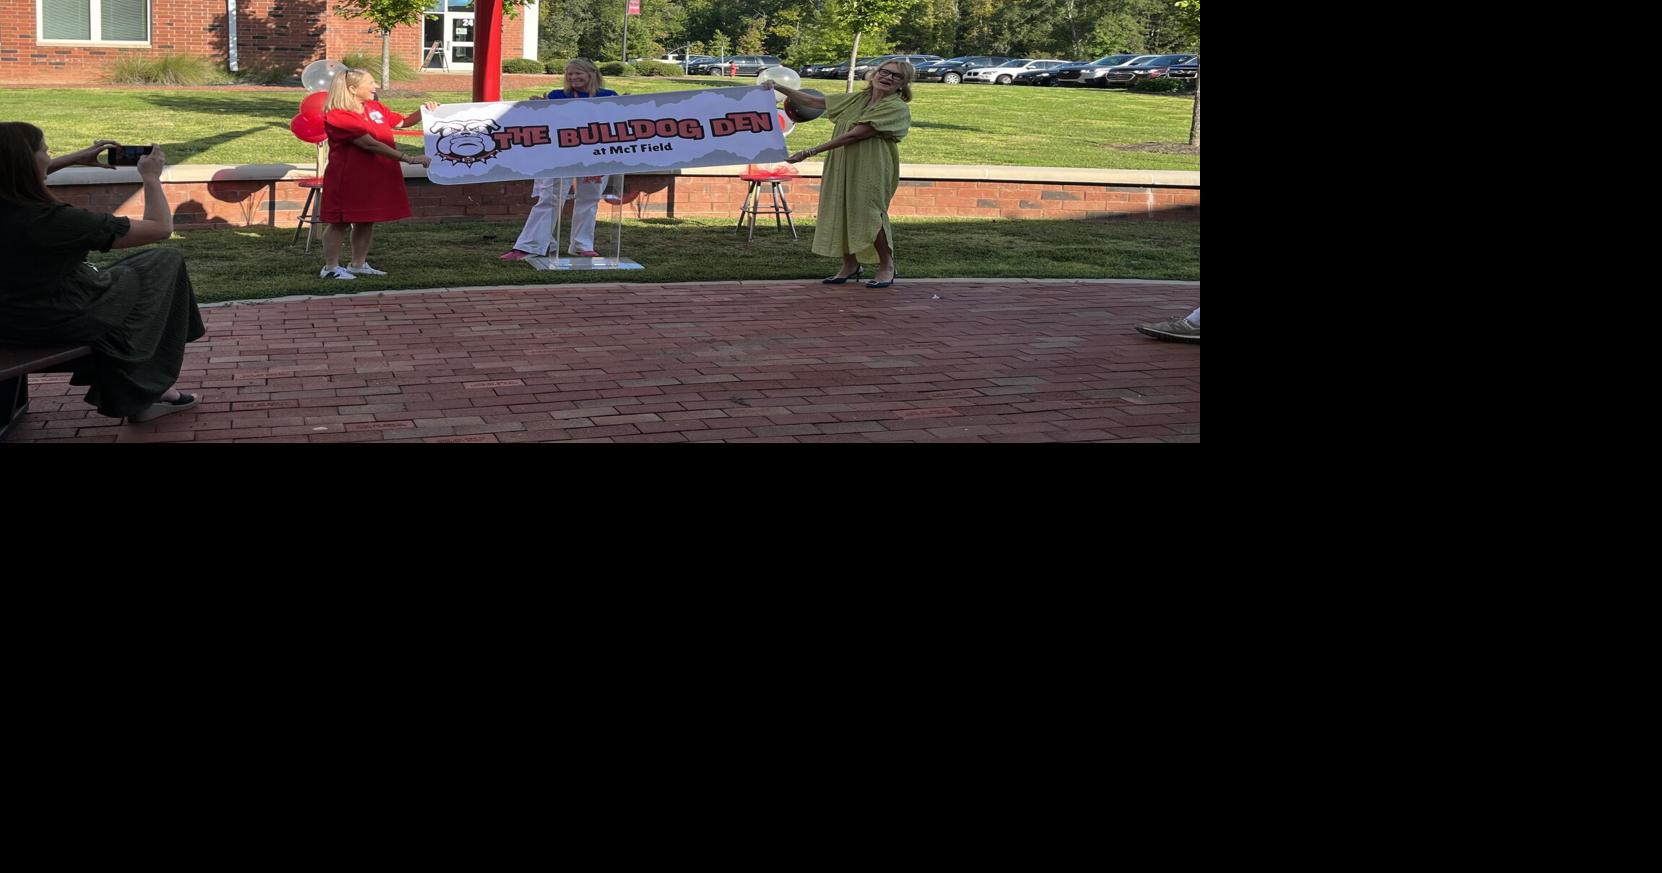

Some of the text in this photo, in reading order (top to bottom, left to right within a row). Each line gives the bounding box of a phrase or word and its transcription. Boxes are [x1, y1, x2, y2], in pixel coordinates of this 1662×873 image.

[493, 111, 773, 150] THE BULLDOG DEN
[592, 142, 673, 156] at McT Field
